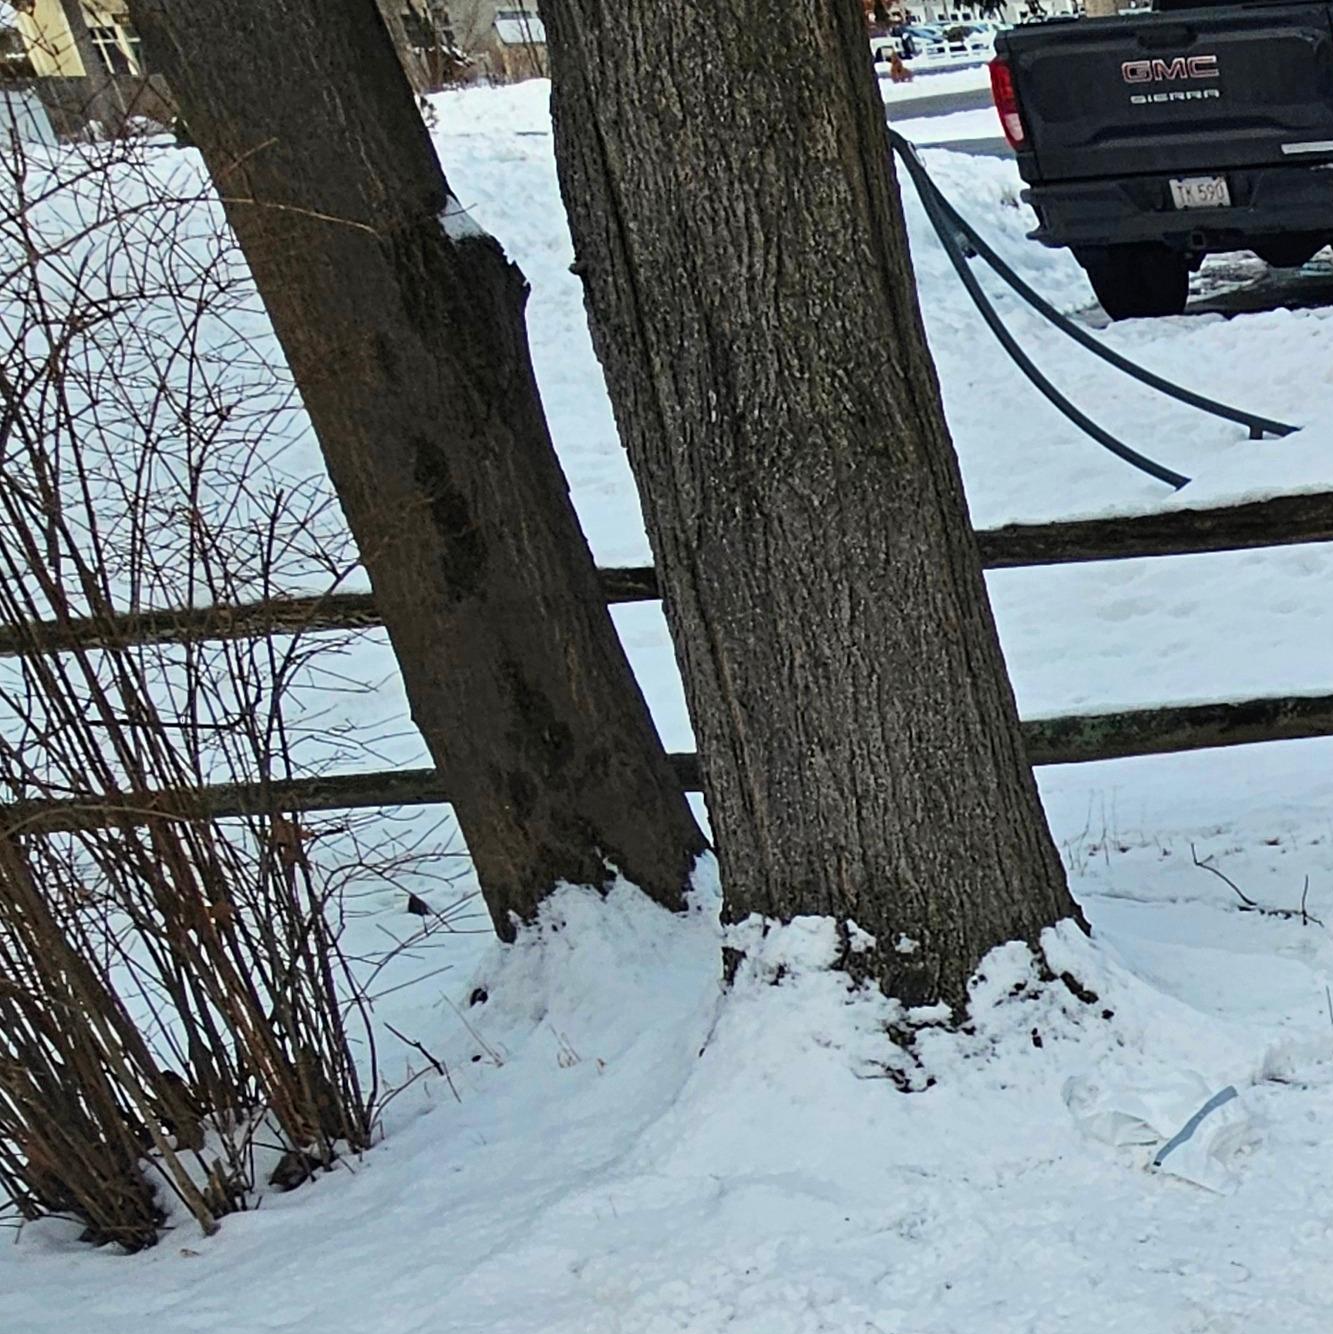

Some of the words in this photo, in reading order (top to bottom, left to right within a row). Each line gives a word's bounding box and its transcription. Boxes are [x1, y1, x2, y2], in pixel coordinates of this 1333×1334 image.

[1121, 55, 1220, 84] GMC
[1130, 89, 1220, 104] SIERRA
[1199, 182, 1225, 202] 590
